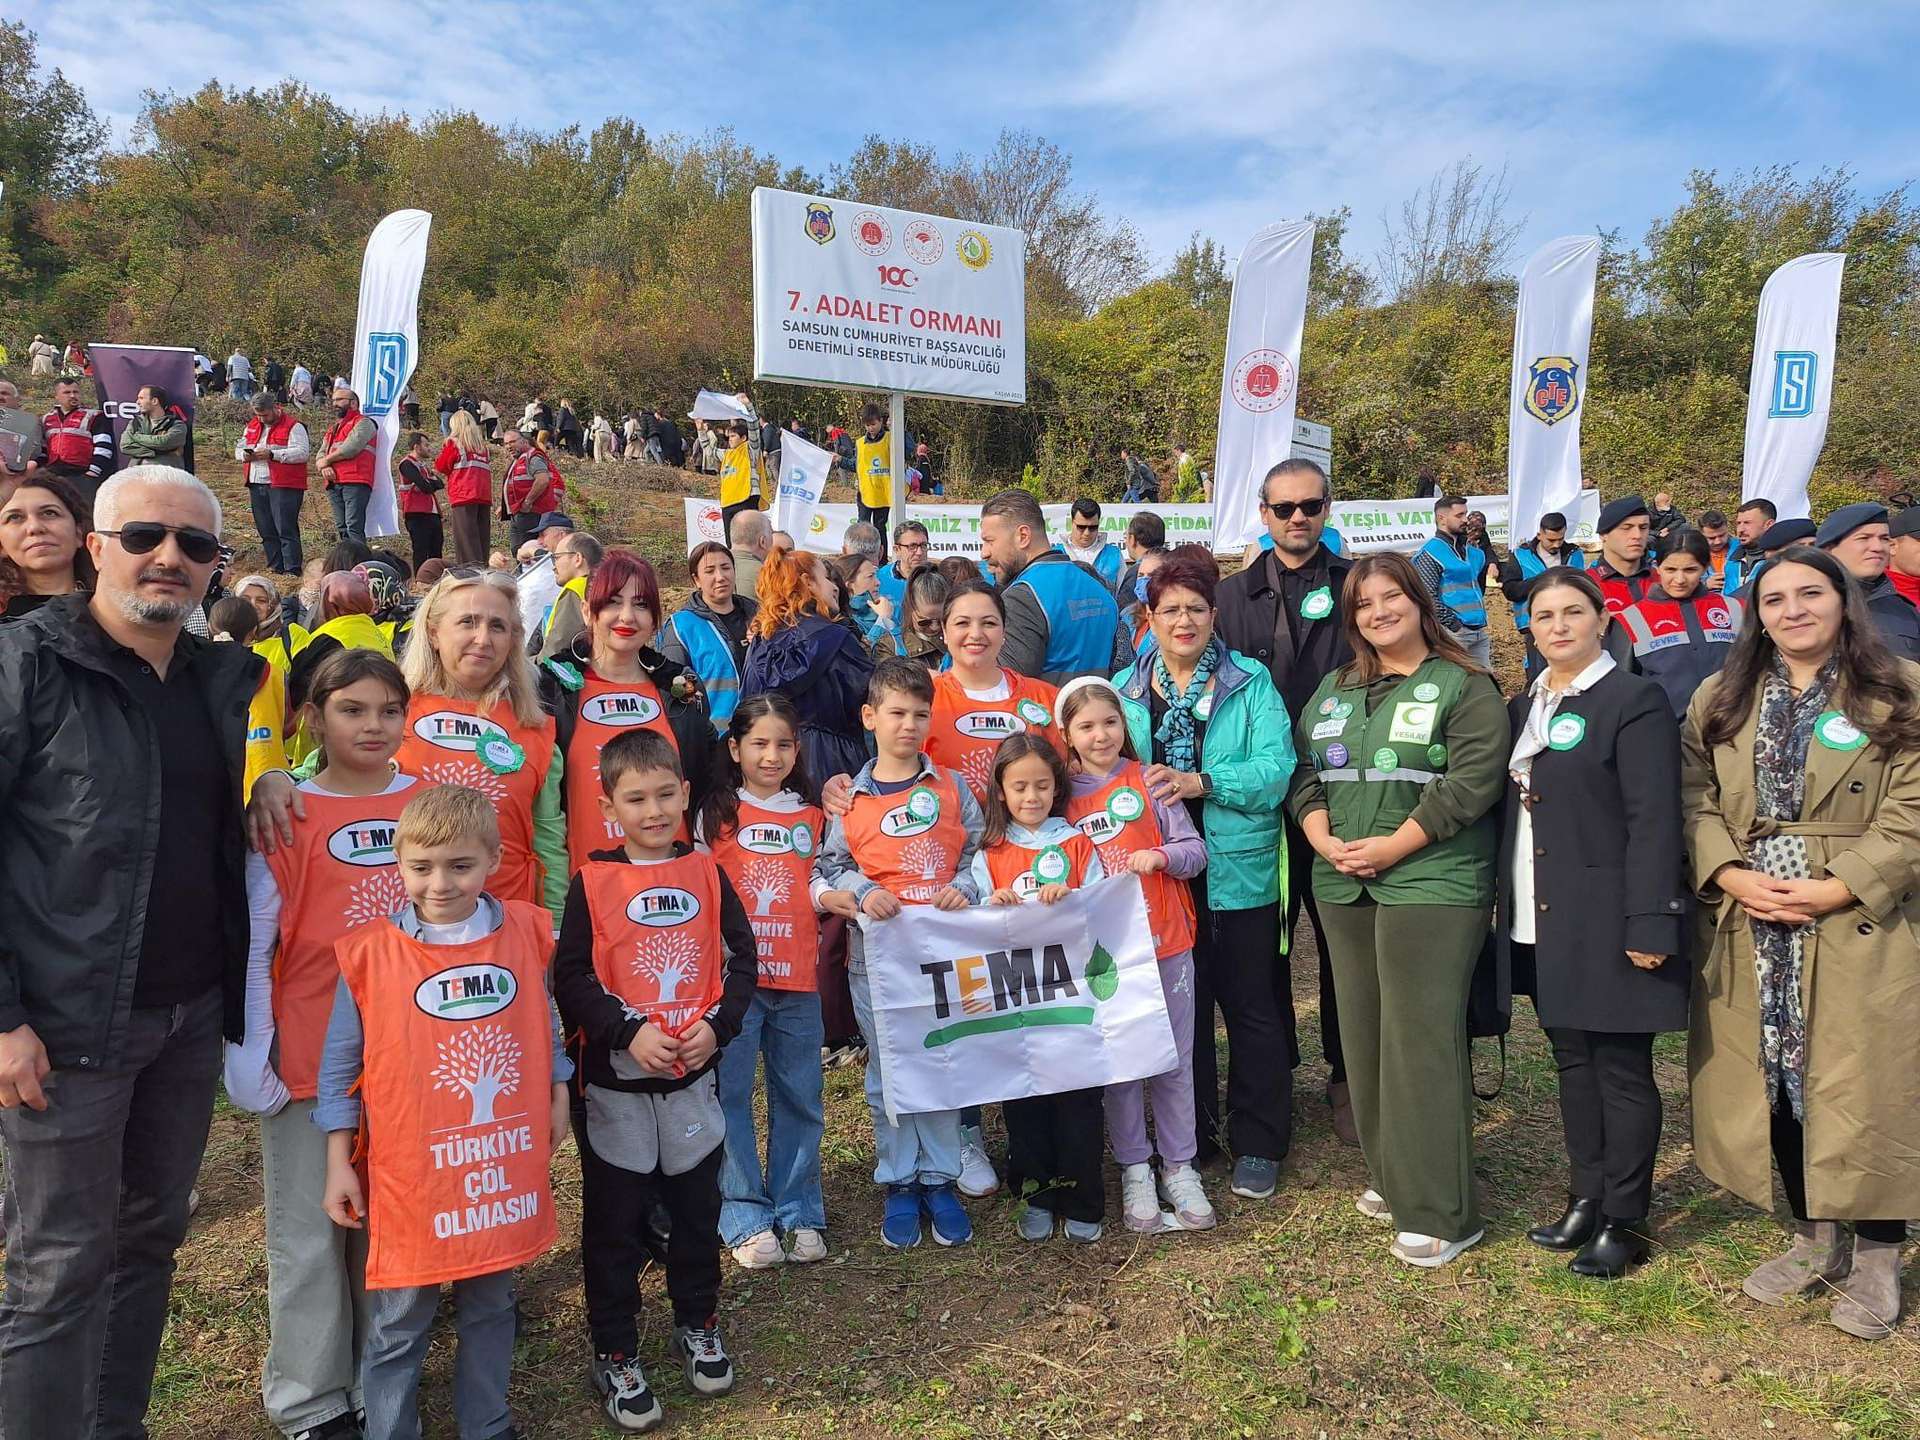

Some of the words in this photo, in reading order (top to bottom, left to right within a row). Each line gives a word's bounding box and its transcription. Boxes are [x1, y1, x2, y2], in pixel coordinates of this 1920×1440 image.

[788, 290, 808, 312] 7.
[816, 294, 903, 324] ADALET
[910, 308, 1000, 338] ORMANI
[782, 320, 839, 337] SAMSUN
[843, 327, 922, 348] CUMHURİYET
[926, 338, 1006, 359] BAŞSAVCILIĞI
[788, 338, 853, 356] DENETİMLİ
[858, 346, 927, 366] SERBESTLİK
[931, 356, 1000, 375] MÜDÜRLÜĞÜ
[103, 401, 140, 419] ce
[1341, 509, 1391, 530] YEŞİL
[1397, 511, 1434, 526] VAT
[1352, 533, 1425, 544] BULUŞALIM
[598, 698, 639, 714] TEMA
[434, 719, 482, 736] TEMA
[970, 717, 1006, 728] TEMA
[751, 829, 781, 842] TEMA
[641, 895, 680, 912] TEMA
[438, 974, 495, 1001] TEMA
[920, 944, 1079, 1019] TEMA
[430, 1125, 533, 1169] TÜRKİYE
[464, 1161, 512, 1204] ÇÖL
[434, 1191, 538, 1239] OLMASIN
